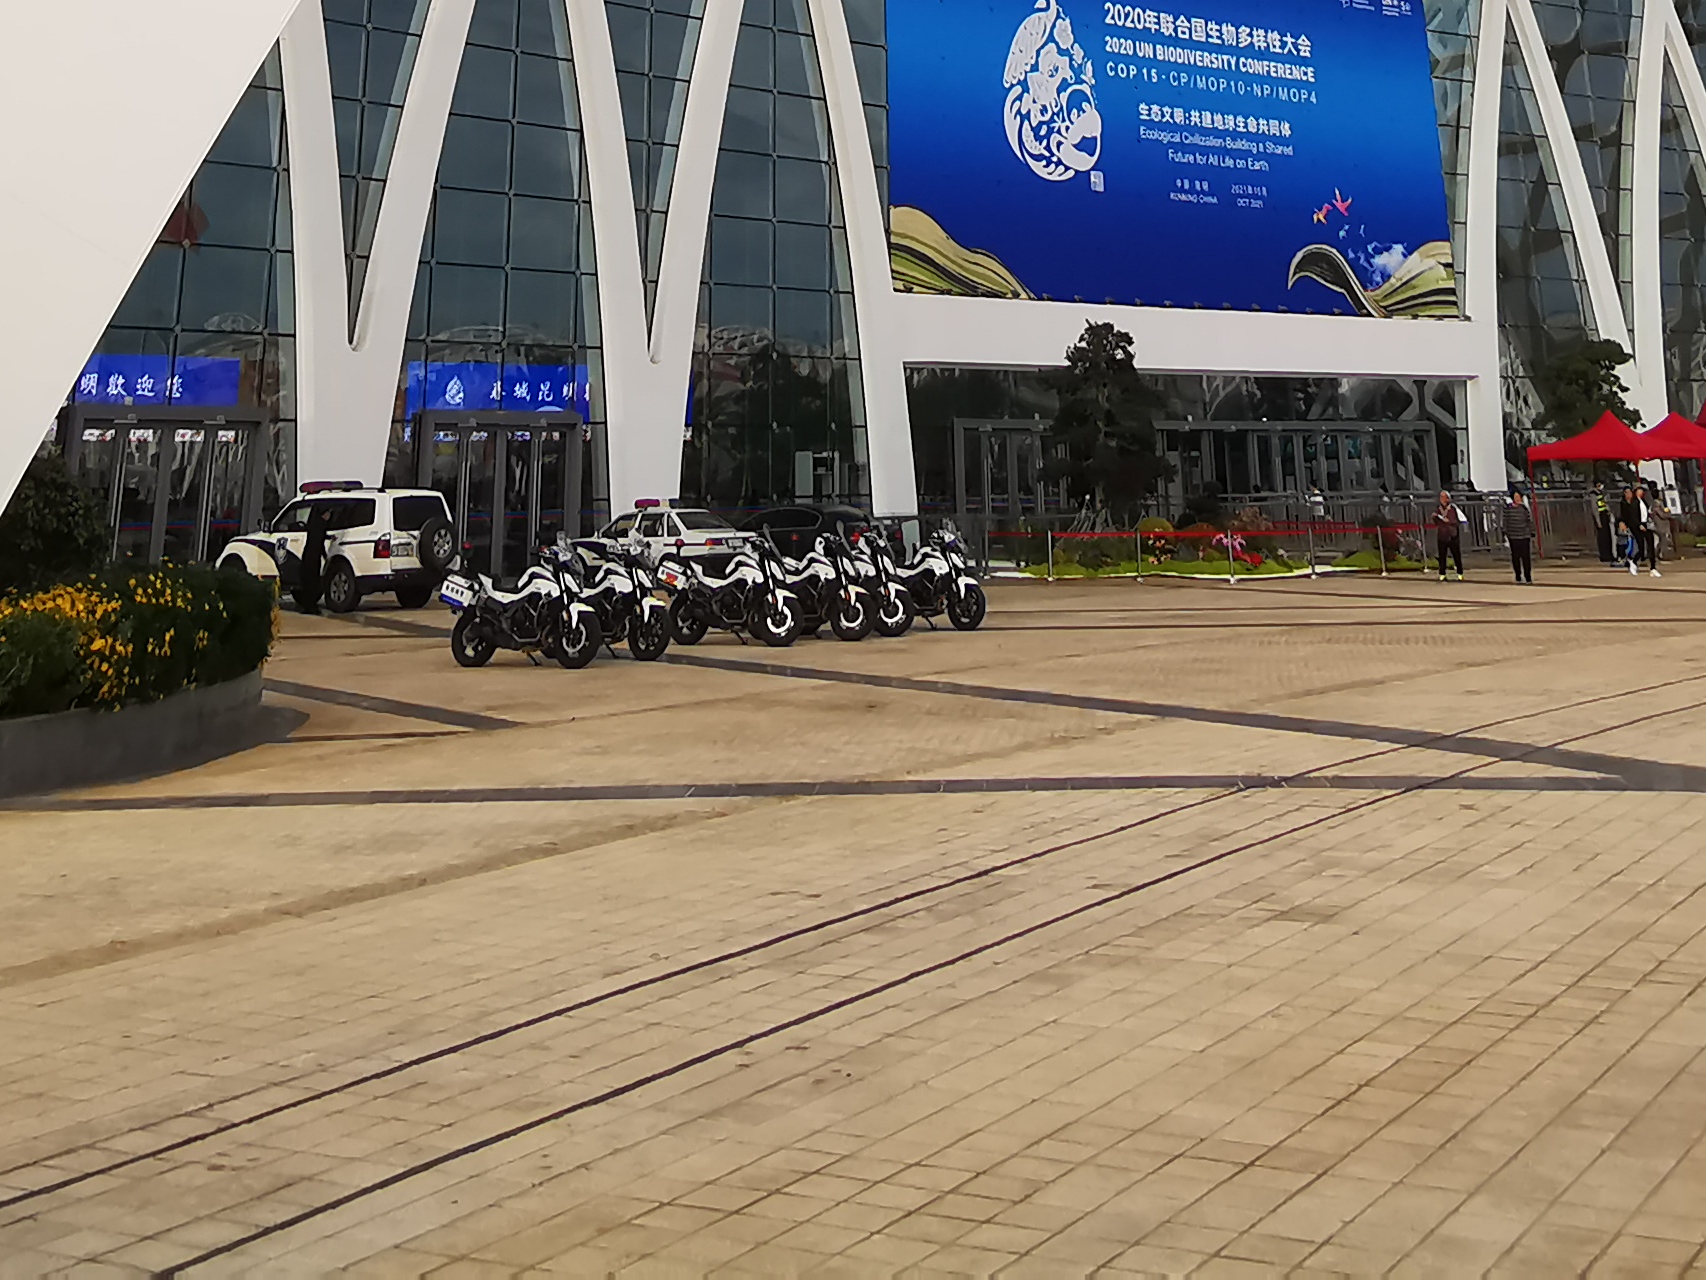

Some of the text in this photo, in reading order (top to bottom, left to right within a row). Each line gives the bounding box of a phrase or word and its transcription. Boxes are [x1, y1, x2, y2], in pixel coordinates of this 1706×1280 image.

[1104, 1, 1312, 58] 2020年联合国生物多样性大会
[1104, 36, 1316, 83] 2020 UN BIODIVERSITY CONFERENCE
[1139, 125, 1181, 144] Ecological
[1265, 140, 1293, 156] Shared
[1168, 148, 1195, 164] Future
[1195, 151, 1207, 165] for
[1207, 153, 1219, 166] All
[1220, 154, 1235, 168] Life
[1247, 157, 1269, 172] Earth
